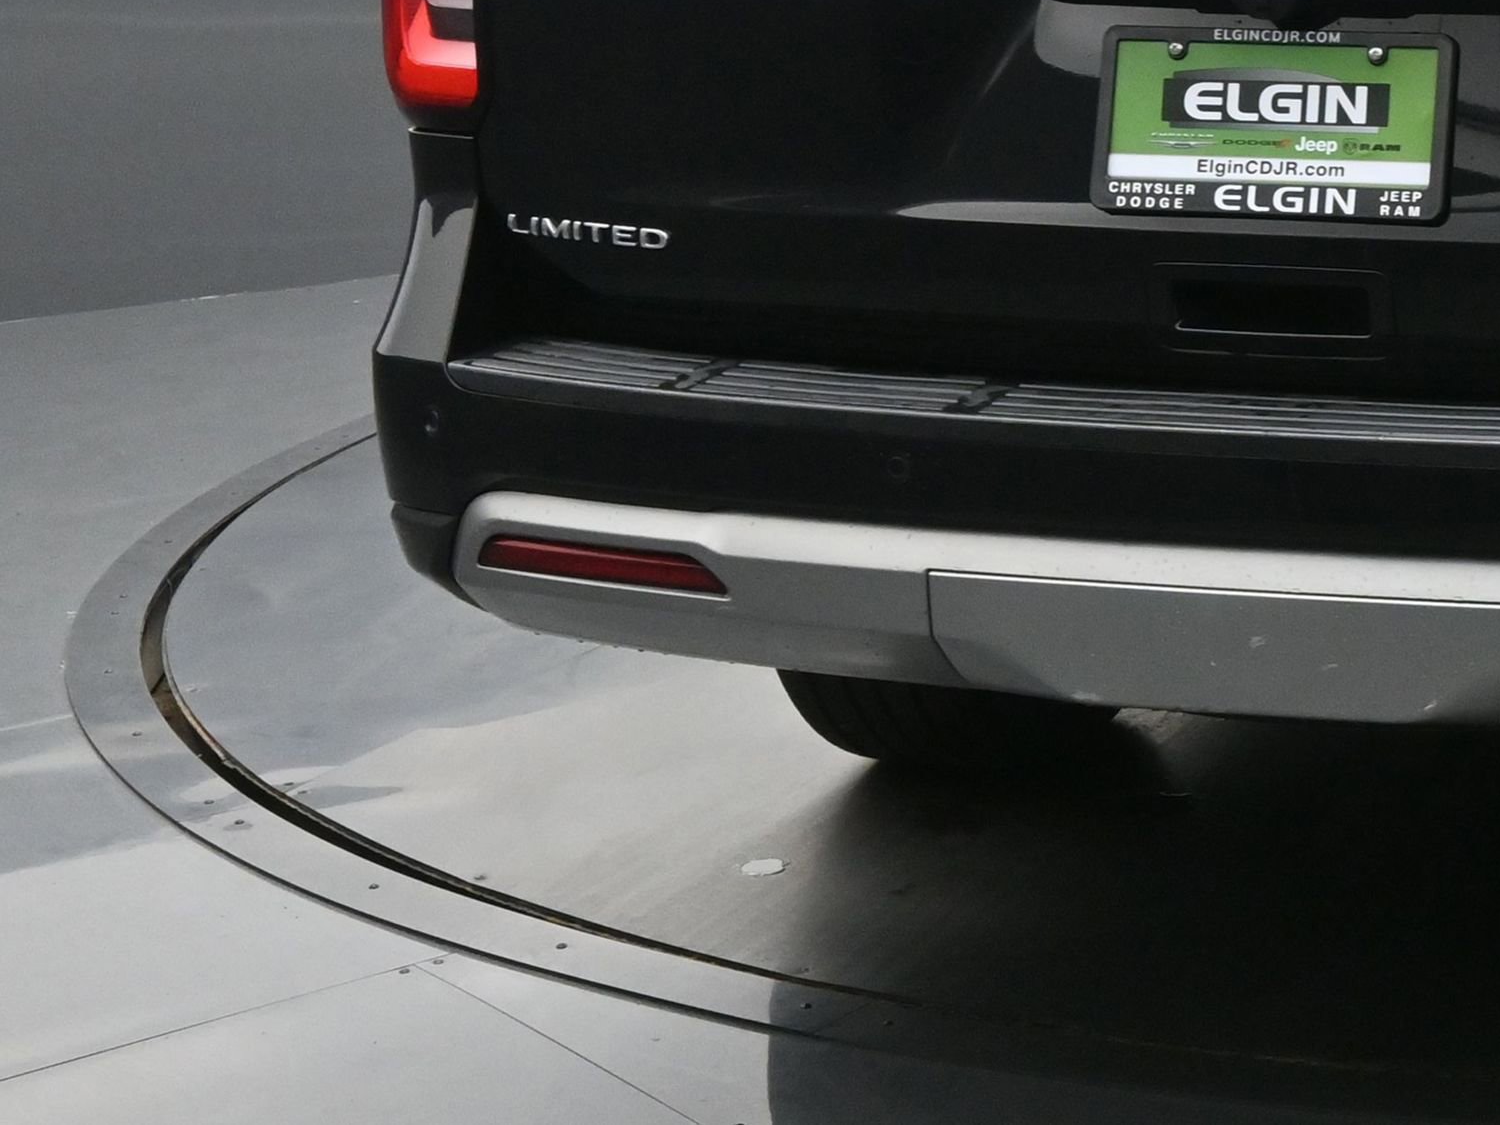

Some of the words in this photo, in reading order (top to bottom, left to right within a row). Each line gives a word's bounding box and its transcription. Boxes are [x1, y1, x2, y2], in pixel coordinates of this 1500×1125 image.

[1212, 28, 1341, 44] ELGINCDJR.COM
[1183, 81, 1368, 125] ELGIN
[1295, 136, 1338, 155] Jeep
[1359, 143, 1401, 152] RAM
[1196, 159, 1345, 178] ElginCDJR.com
[1108, 181, 1196, 196] CHRYSLER
[1379, 190, 1423, 203] JEEP
[1115, 196, 1184, 209] DODGE
[1213, 184, 1357, 215] ELGIN
[1379, 205, 1421, 217] RAM
[507, 213, 669, 249] LIMITED
